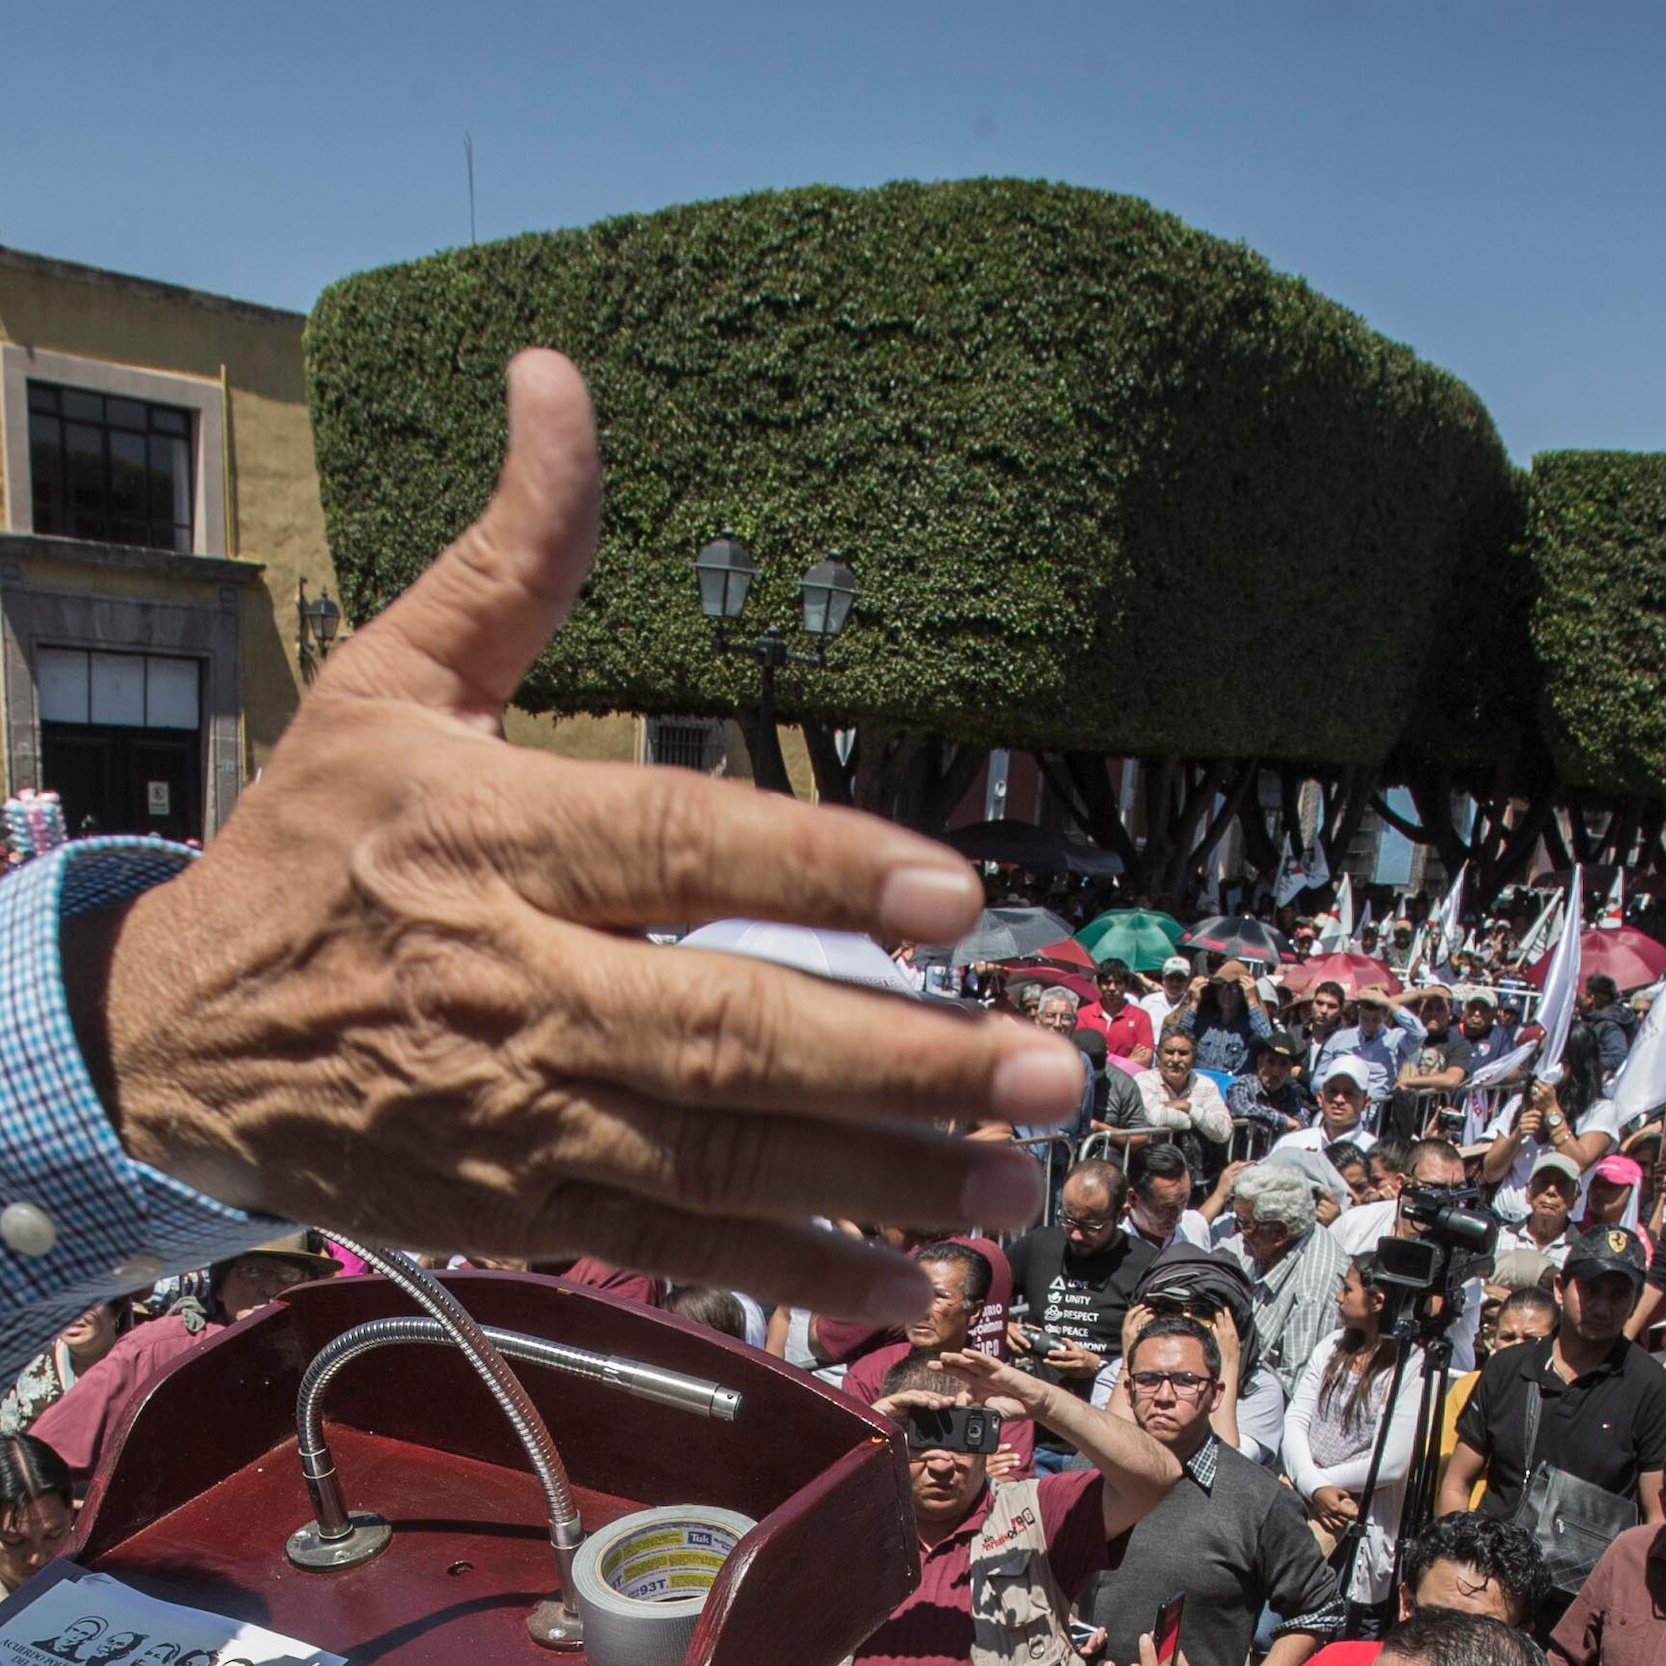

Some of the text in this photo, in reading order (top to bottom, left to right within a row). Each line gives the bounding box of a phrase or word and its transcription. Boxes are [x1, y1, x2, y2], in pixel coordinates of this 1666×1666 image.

[1068, 1279, 1089, 1290] LOVE
[1065, 1294, 1092, 1306] UNITY
[1063, 1309, 1100, 1323] RESPECT
[1062, 1327, 1089, 1338] PEACE
[690, 1532, 710, 1545] Tuk
[639, 1578, 667, 1596] 93T
[0, 1638, 48, 1662] ACUERDO
[10, 1654, 31, 1666] DEL
